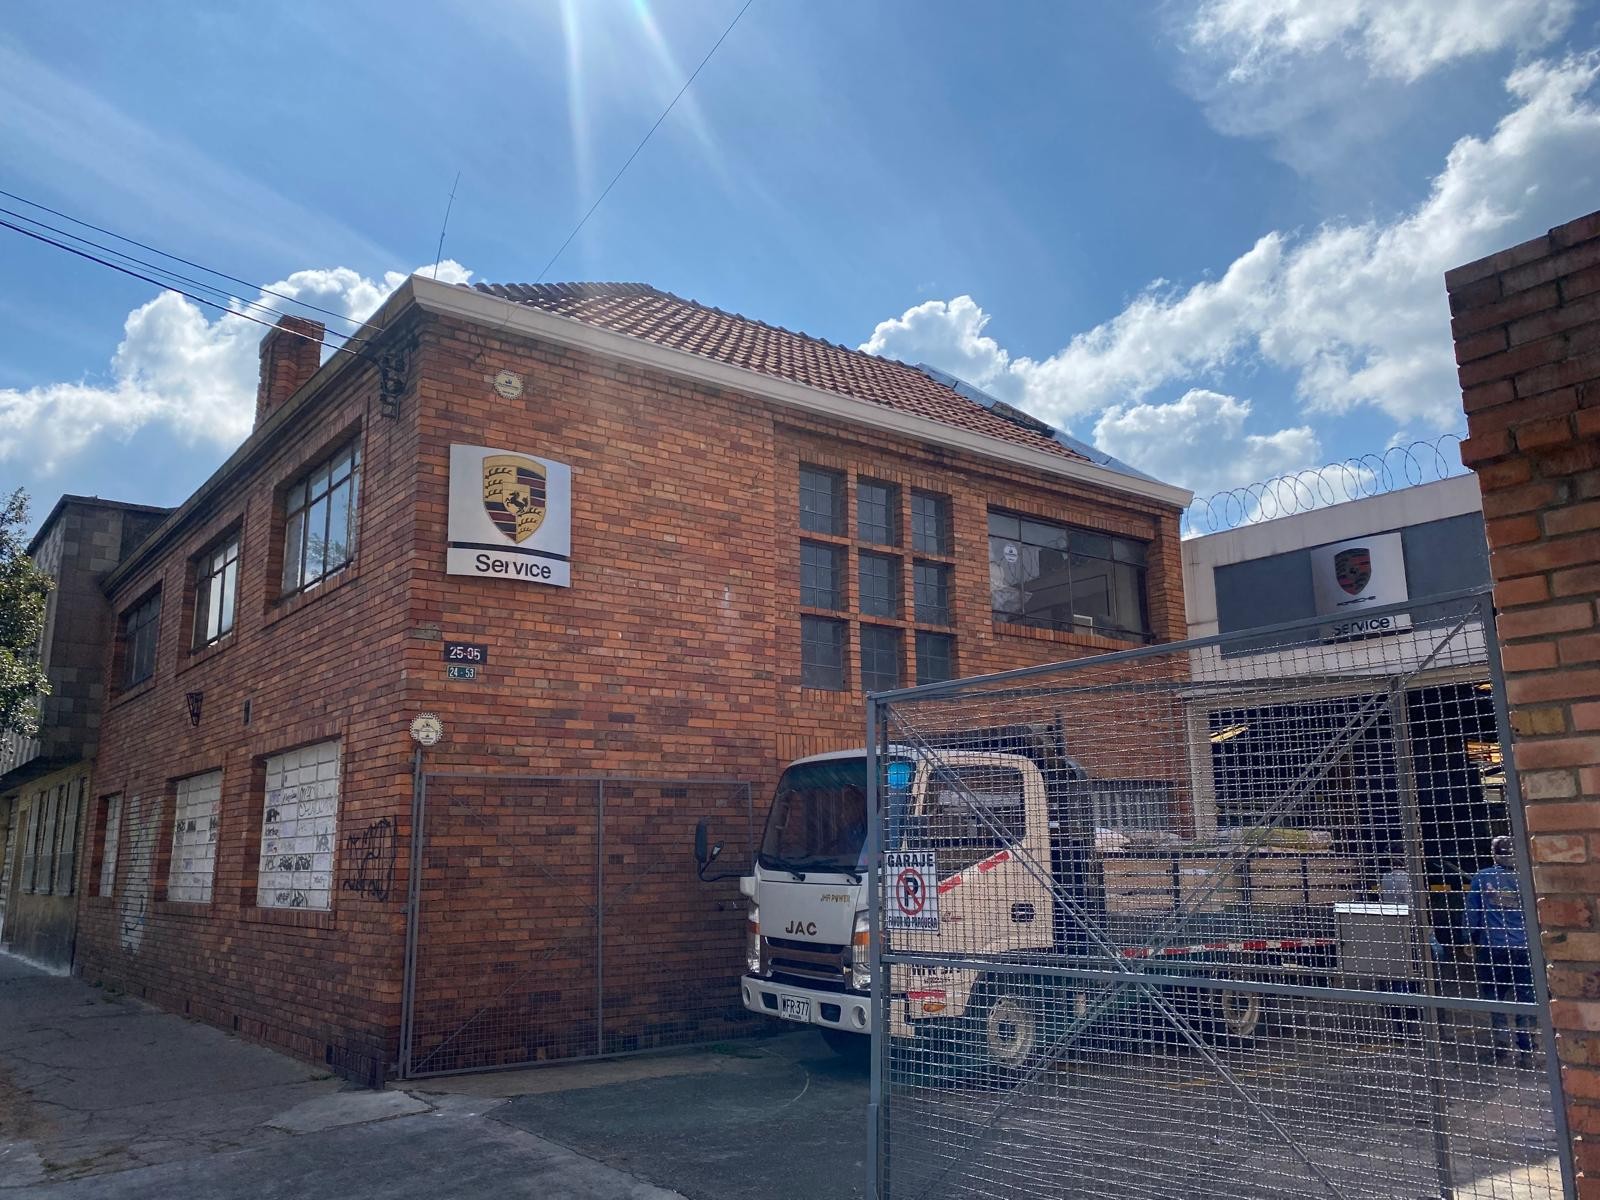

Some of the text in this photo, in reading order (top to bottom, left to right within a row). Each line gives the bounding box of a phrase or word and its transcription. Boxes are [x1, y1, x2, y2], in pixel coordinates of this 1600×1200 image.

[475, 554, 552, 579] Service
[887, 853, 934, 867] GARAJE
[785, 921, 817, 936] JAC
